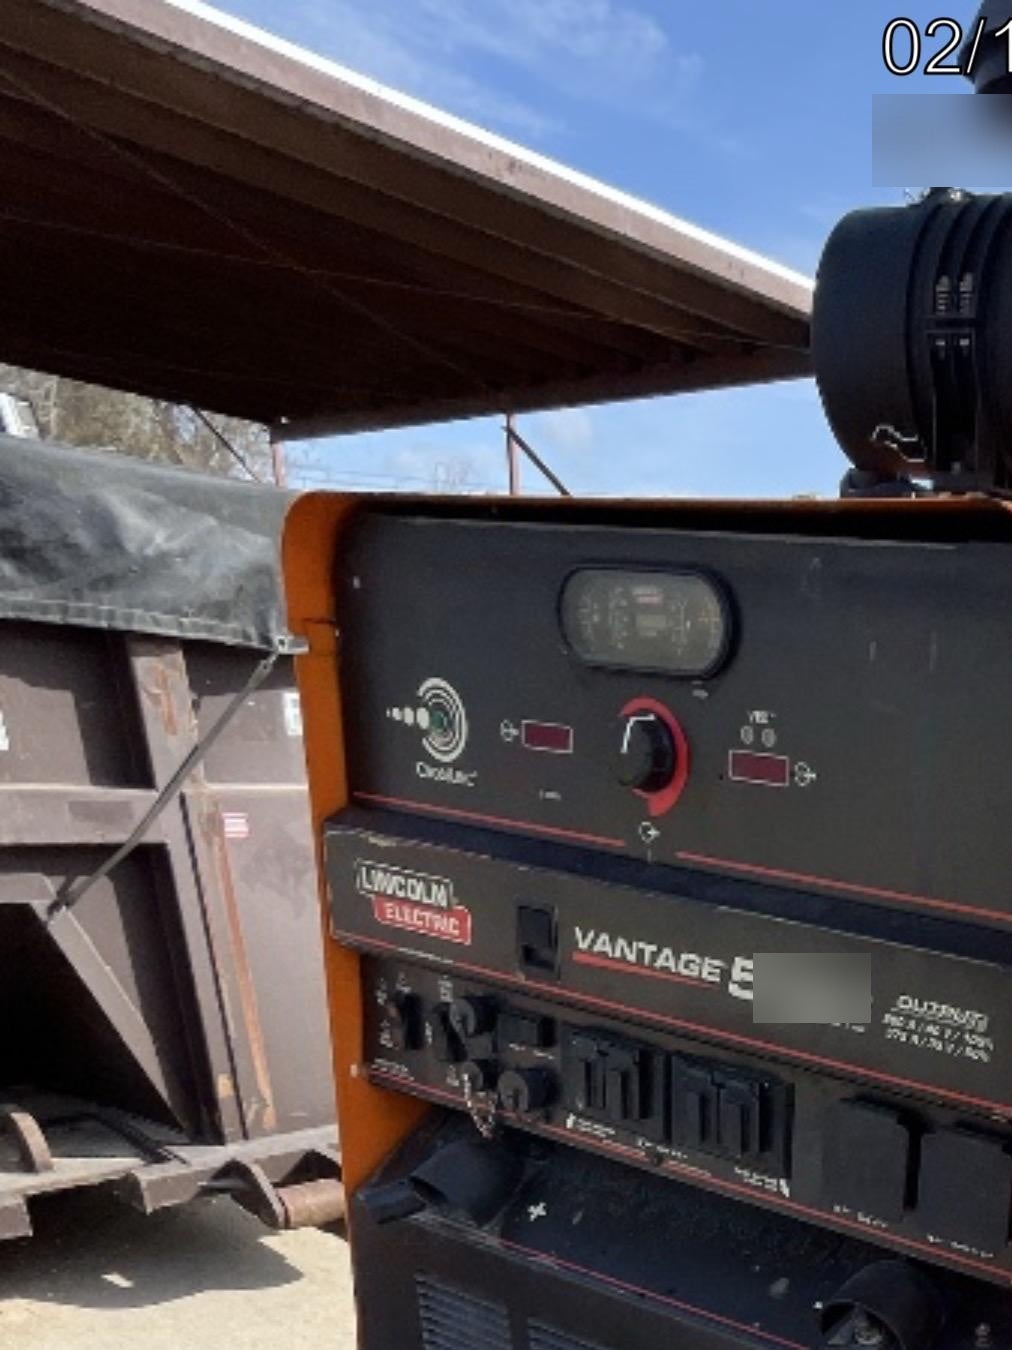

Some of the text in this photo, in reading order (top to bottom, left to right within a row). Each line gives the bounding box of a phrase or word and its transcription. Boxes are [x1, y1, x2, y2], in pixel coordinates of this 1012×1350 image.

[360, 865, 449, 909] LINCOLN
[383, 902, 461, 936] ELECTRIC
[574, 926, 724, 983] VANTAGE
